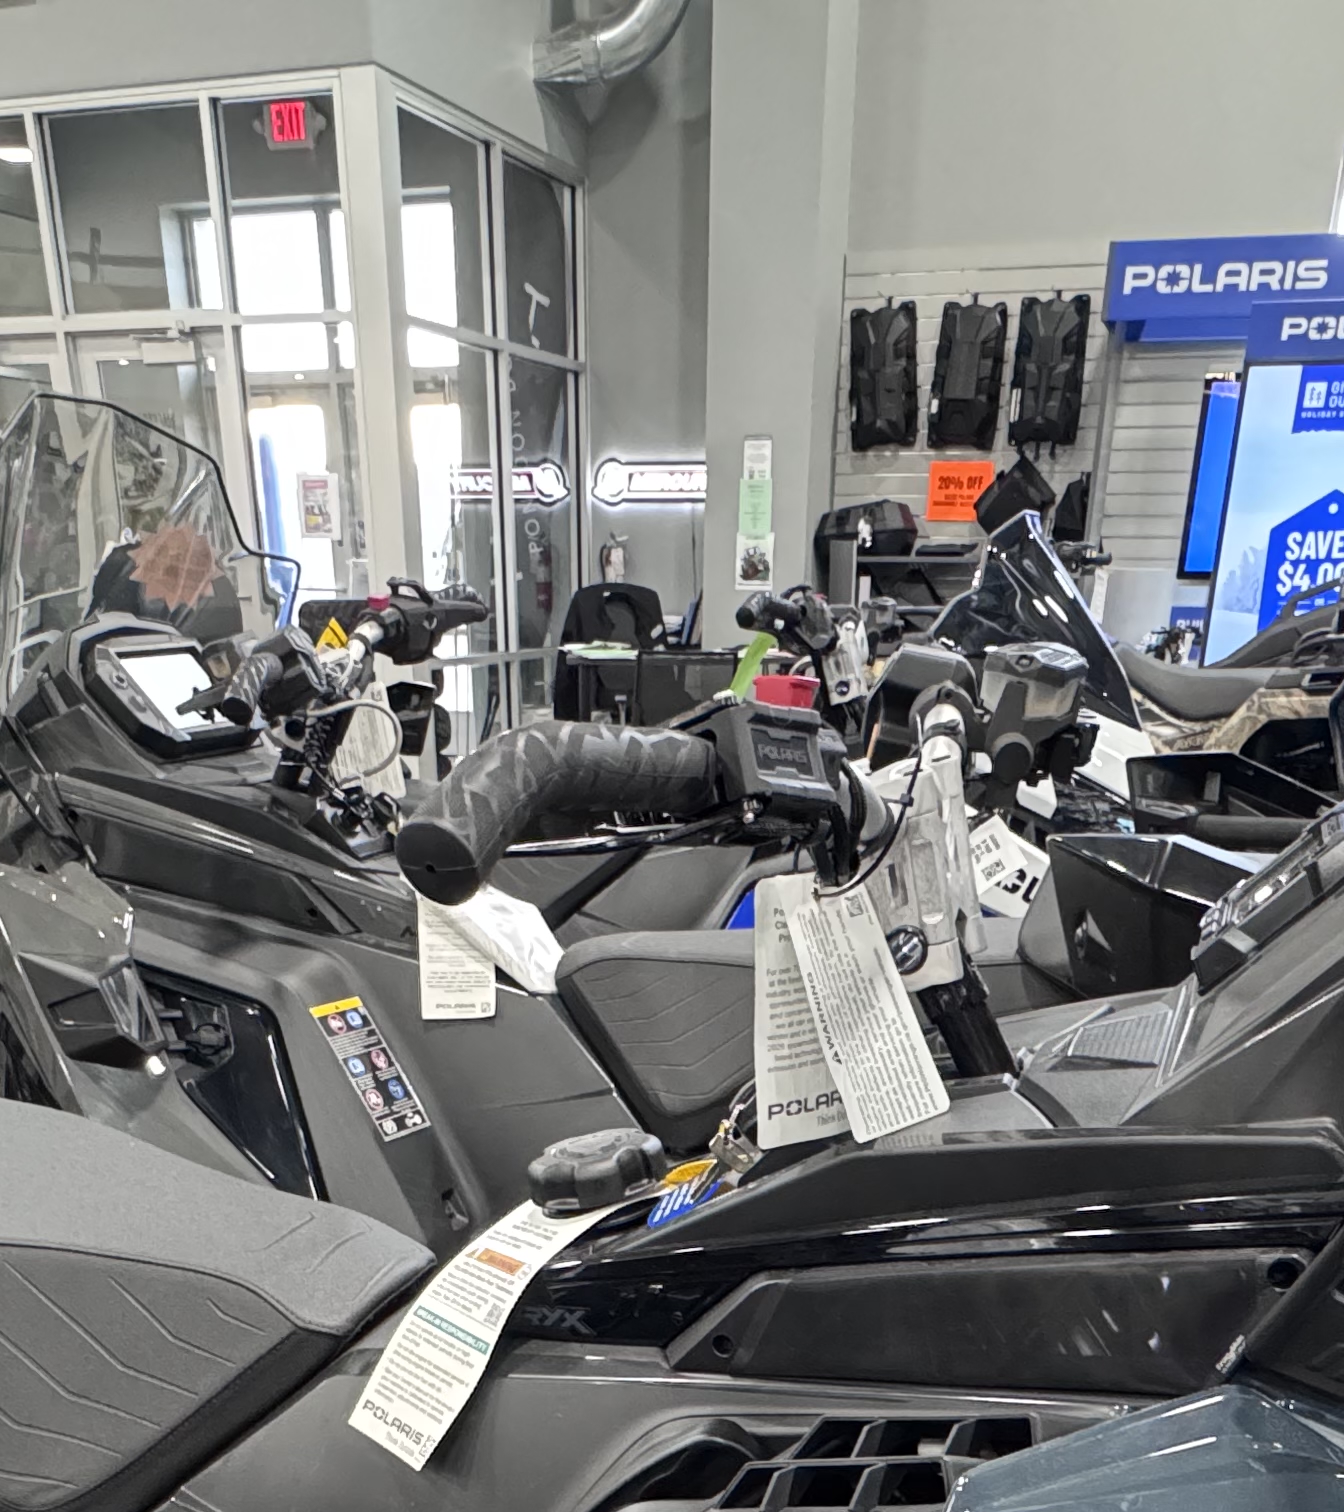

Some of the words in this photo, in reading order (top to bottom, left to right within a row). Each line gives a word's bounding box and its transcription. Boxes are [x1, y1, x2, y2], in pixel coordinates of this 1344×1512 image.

[270, 101, 306, 142] EXIT
[1122, 259, 1329, 295] POLARIS
[1301, 410, 1337, 418] HOLIDAY
[938, 475, 964, 490] 20%
[967, 475, 984, 490] OFF
[806, 971, 836, 1050] WARNING
[362, 1399, 425, 1446] POLARIS
